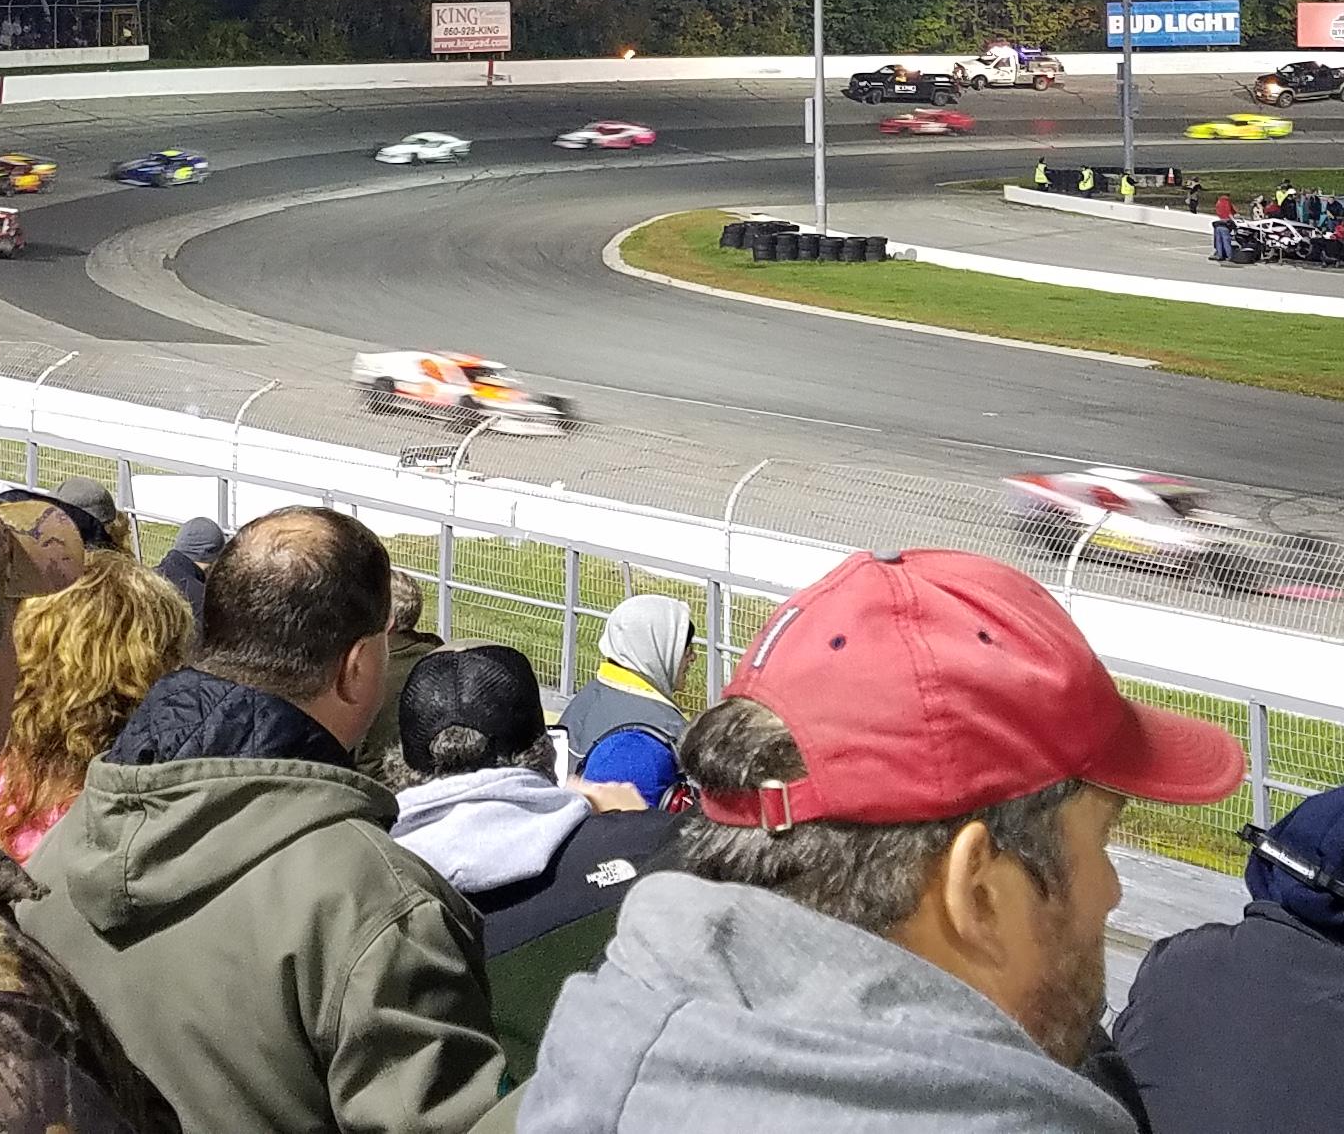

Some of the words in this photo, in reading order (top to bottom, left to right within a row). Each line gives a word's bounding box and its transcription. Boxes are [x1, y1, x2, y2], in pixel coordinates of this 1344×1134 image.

[436, 7, 478, 26] KING
[1108, 14, 1162, 34] BUD
[1164, 12, 1239, 33] LIGHT
